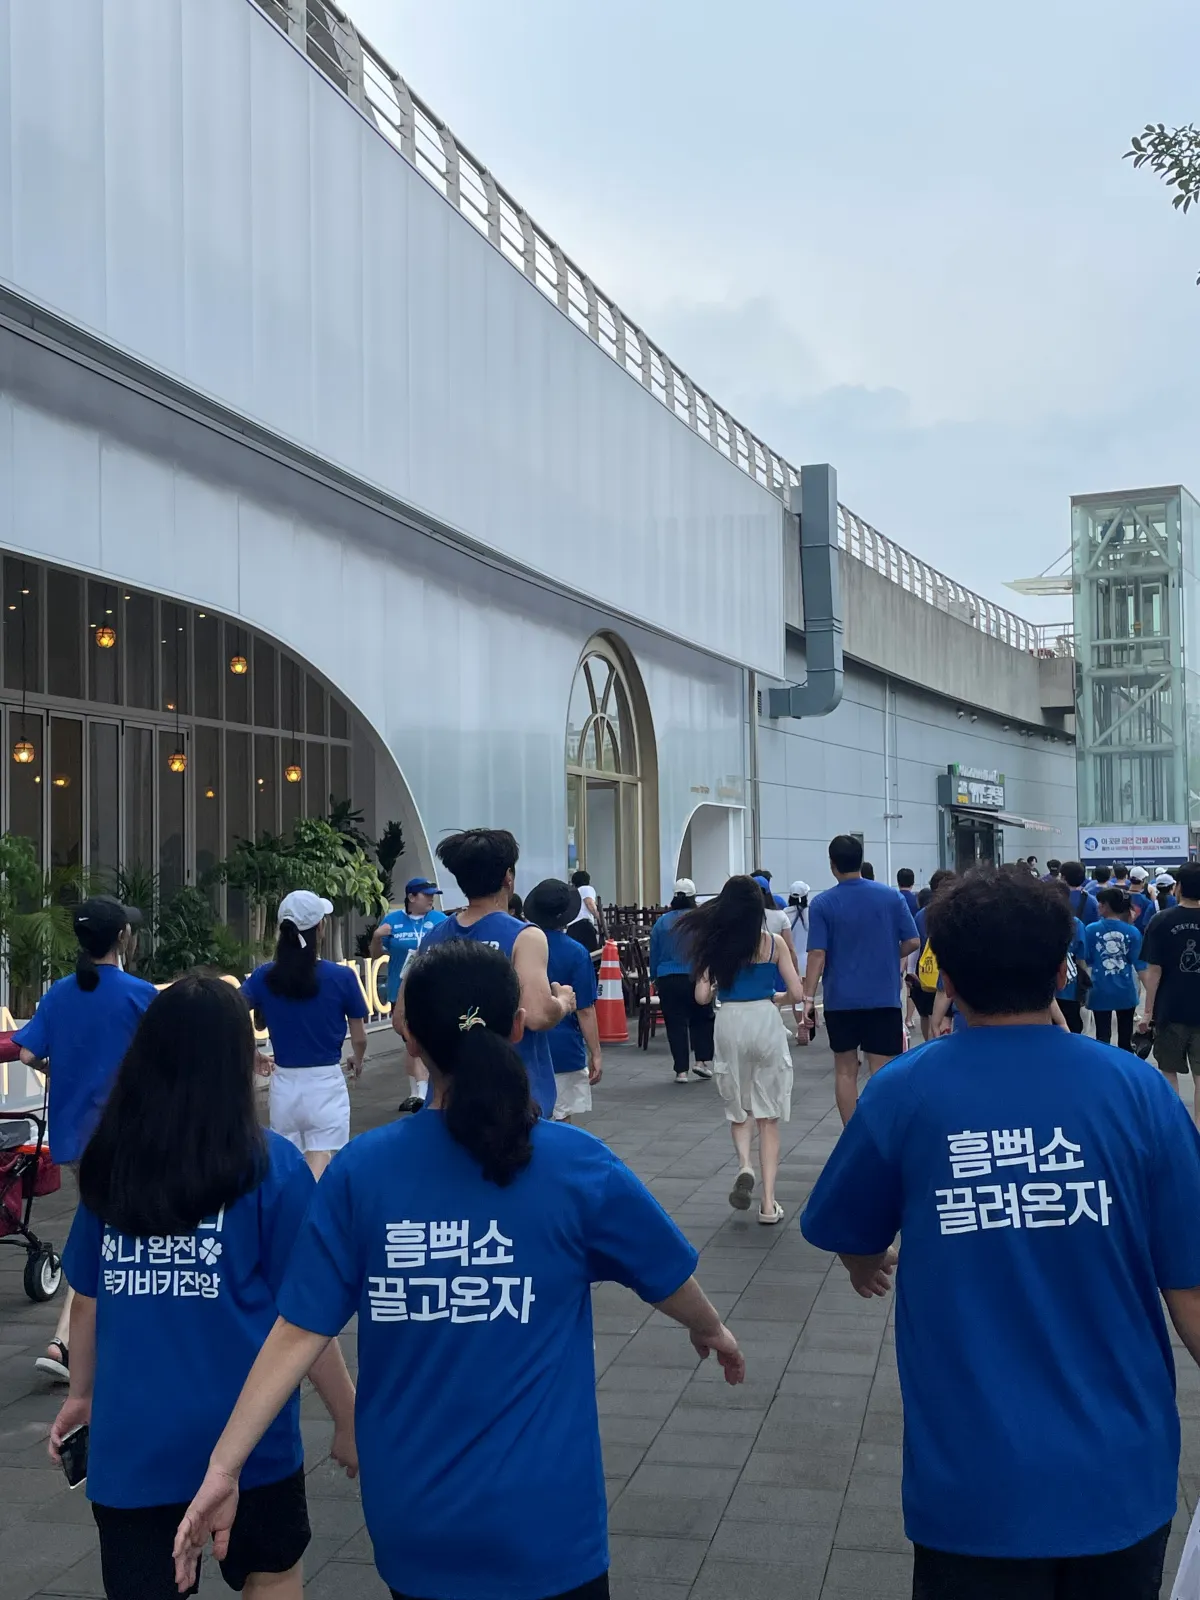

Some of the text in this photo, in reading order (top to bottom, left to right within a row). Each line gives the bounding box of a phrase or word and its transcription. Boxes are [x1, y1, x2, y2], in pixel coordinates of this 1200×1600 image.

[946, 1127, 1085, 1179] 흠뻑쇼
[935, 1180, 1113, 1235] 끌려온자
[117, 1234, 197, 1265] 나 완전
[384, 1219, 514, 1269] 흠뻑쇼
[368, 1276, 536, 1324] 끌고온자
